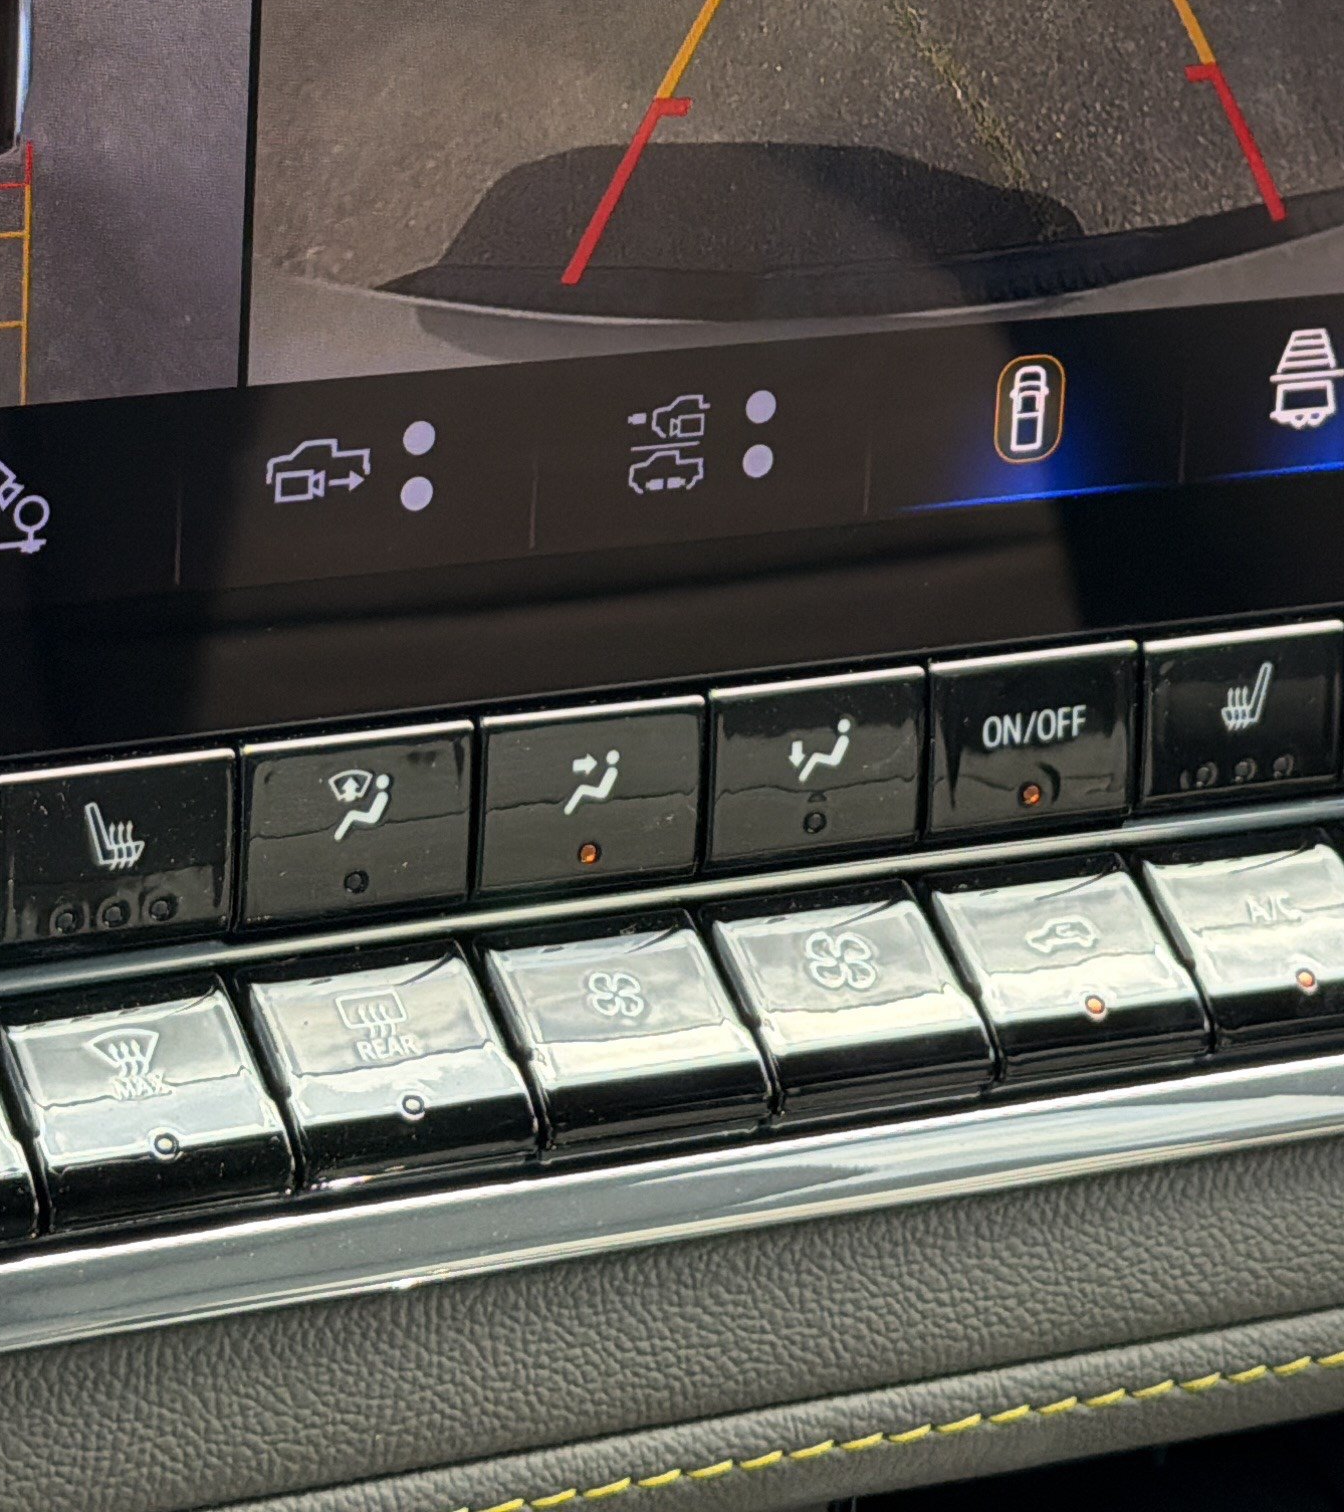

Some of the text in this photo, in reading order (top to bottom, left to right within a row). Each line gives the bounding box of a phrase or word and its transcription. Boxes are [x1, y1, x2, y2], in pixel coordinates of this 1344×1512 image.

[982, 704, 1087, 749] ON/OFF
[1246, 892, 1304, 923] A/C
[356, 1033, 419, 1062] REAR
[111, 1071, 171, 1101] MAX
